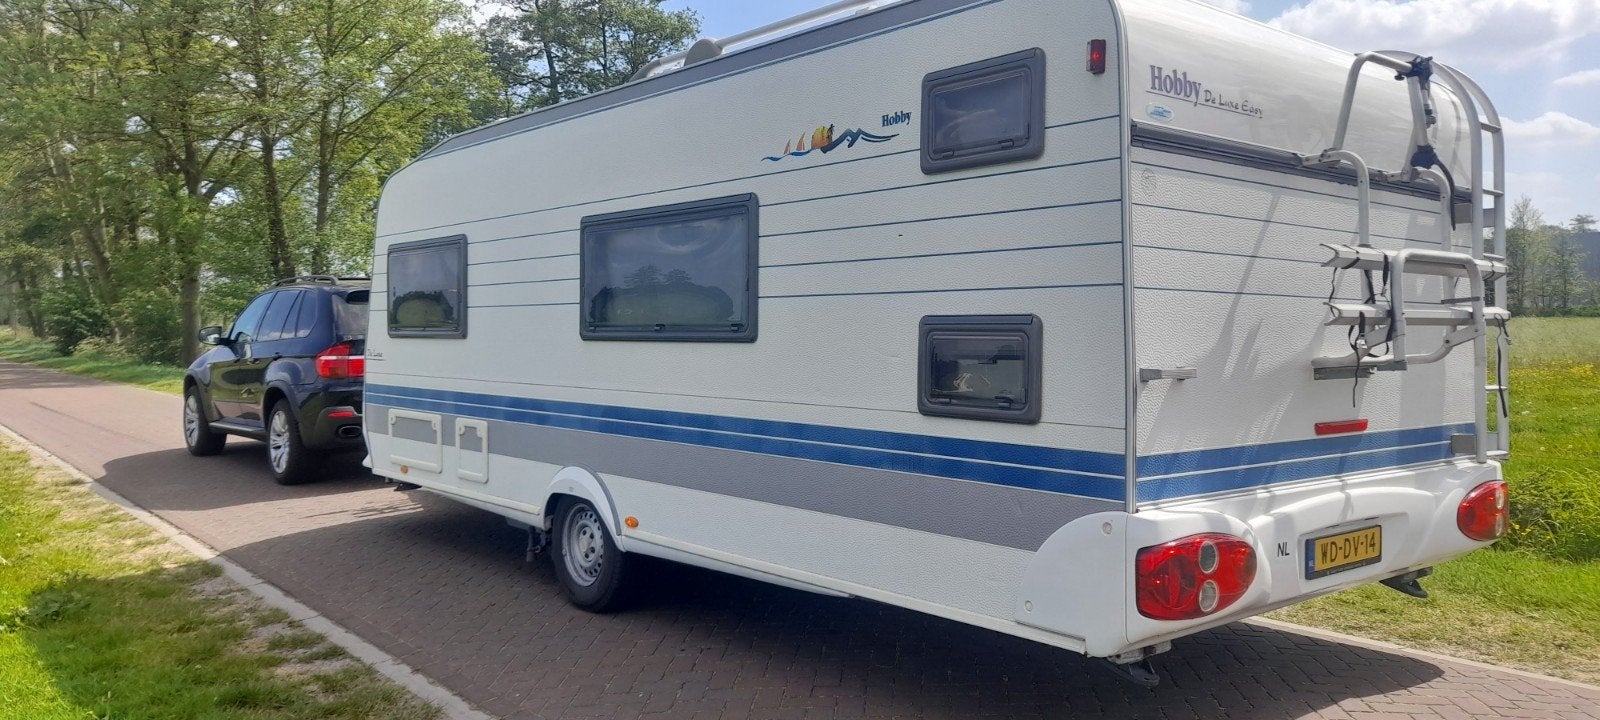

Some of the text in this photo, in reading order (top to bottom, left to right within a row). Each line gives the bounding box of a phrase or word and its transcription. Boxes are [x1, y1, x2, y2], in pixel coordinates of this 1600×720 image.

[1149, 65, 1263, 119] Hobby De Luxe Easy
[881, 110, 912, 127] Hobby
[1277, 542, 1290, 557] NL
[1320, 532, 1376, 564] WD-DV-14
